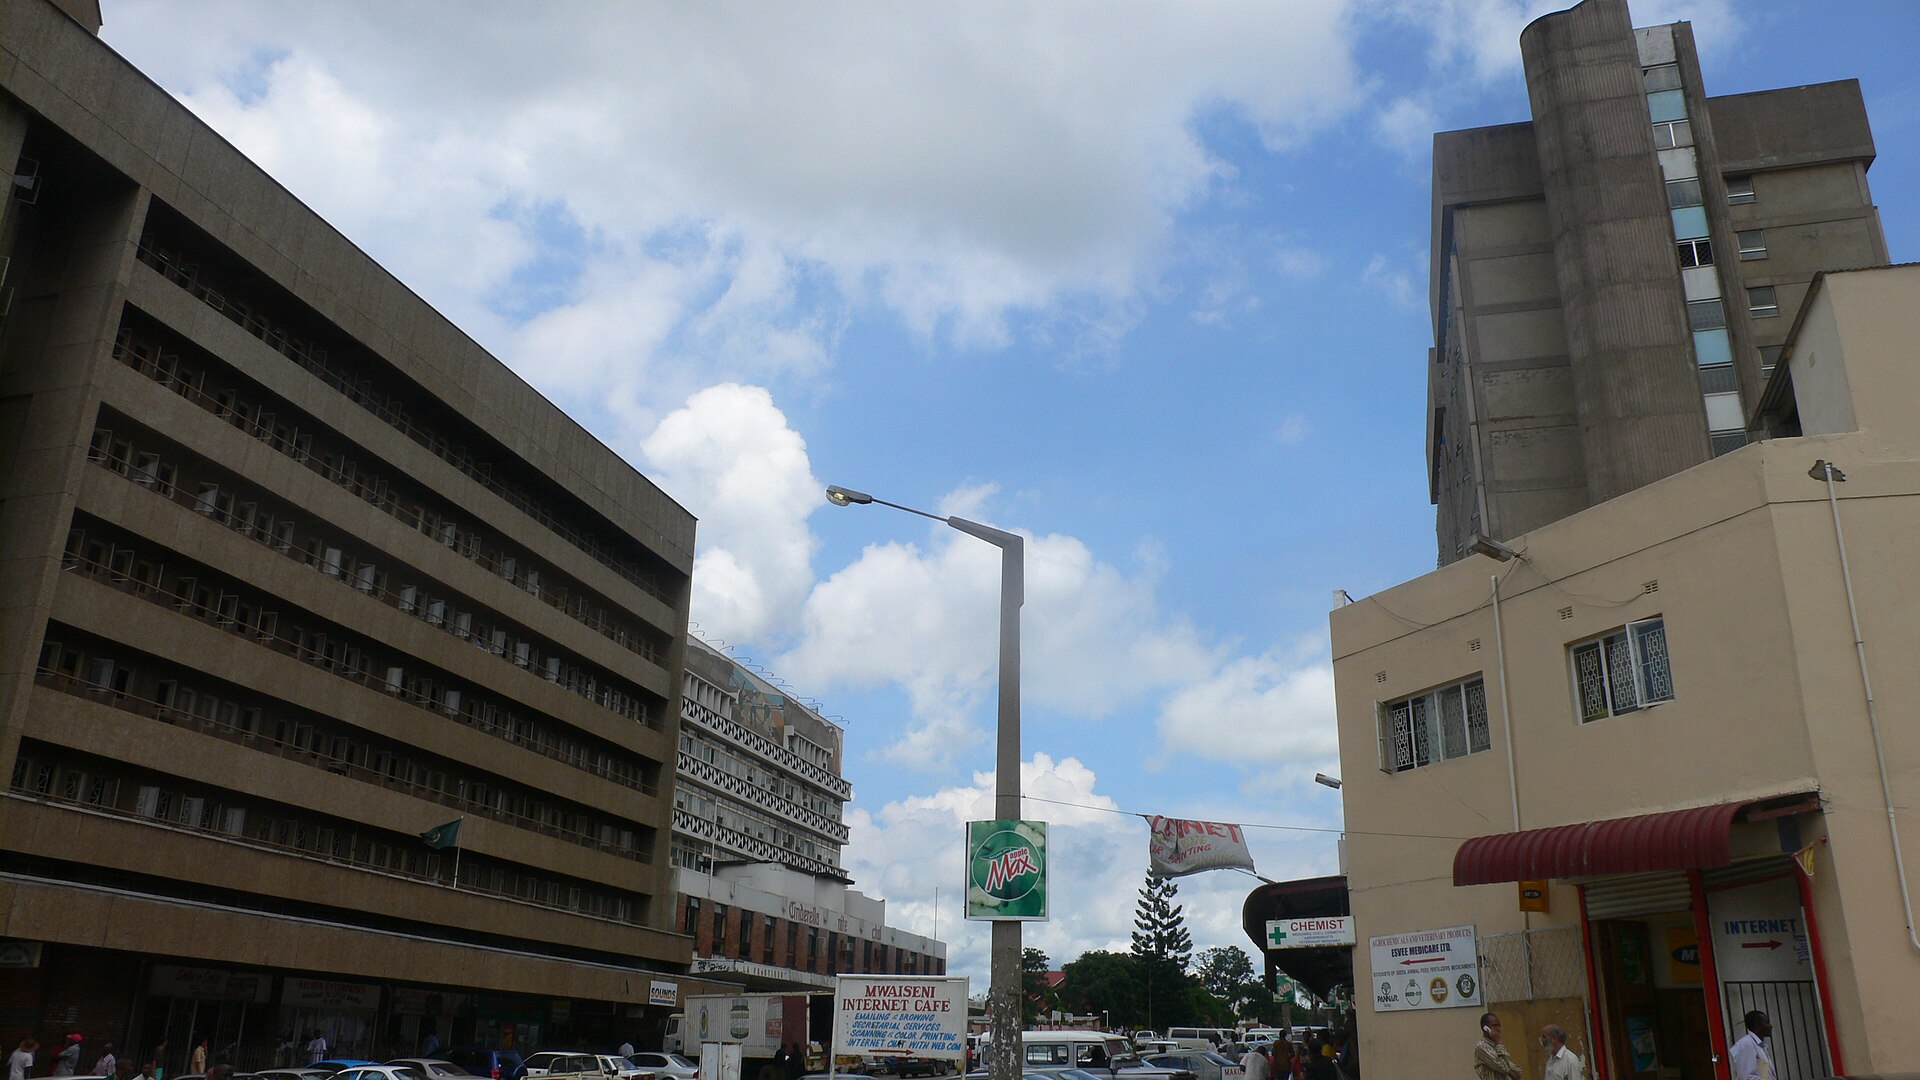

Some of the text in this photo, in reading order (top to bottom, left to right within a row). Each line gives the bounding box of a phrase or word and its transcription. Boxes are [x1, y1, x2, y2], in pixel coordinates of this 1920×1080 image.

[1009, 848, 1028, 859] apple
[985, 853, 1038, 893] Max
[1290, 919, 1345, 931] CHEMIST
[1724, 919, 1797, 935] INTERNET
[1446, 928, 1473, 939] PRODUCTS
[1391, 942, 1453, 958] ESVEE MEDICARE LTD.
[651, 987, 676, 1000] SOUNDS
[865, 985, 936, 999] MWAISENI
[842, 998, 910, 1012] INTERNET
[854, 1012, 891, 1021] EMAILING
[898, 1013, 936, 1022] BROWING
[852, 1020, 942, 1031] SECRETARIAL SERVICES
[850, 1029, 887, 1039] SCANNING
[894, 1031, 917, 1040] COLOR
[919, 1032, 958, 1041] PRINTING
[847, 1038, 887, 1048] INTERNET
[908, 1041, 930, 1050] WITH
[930, 1042, 946, 1051] WEB
